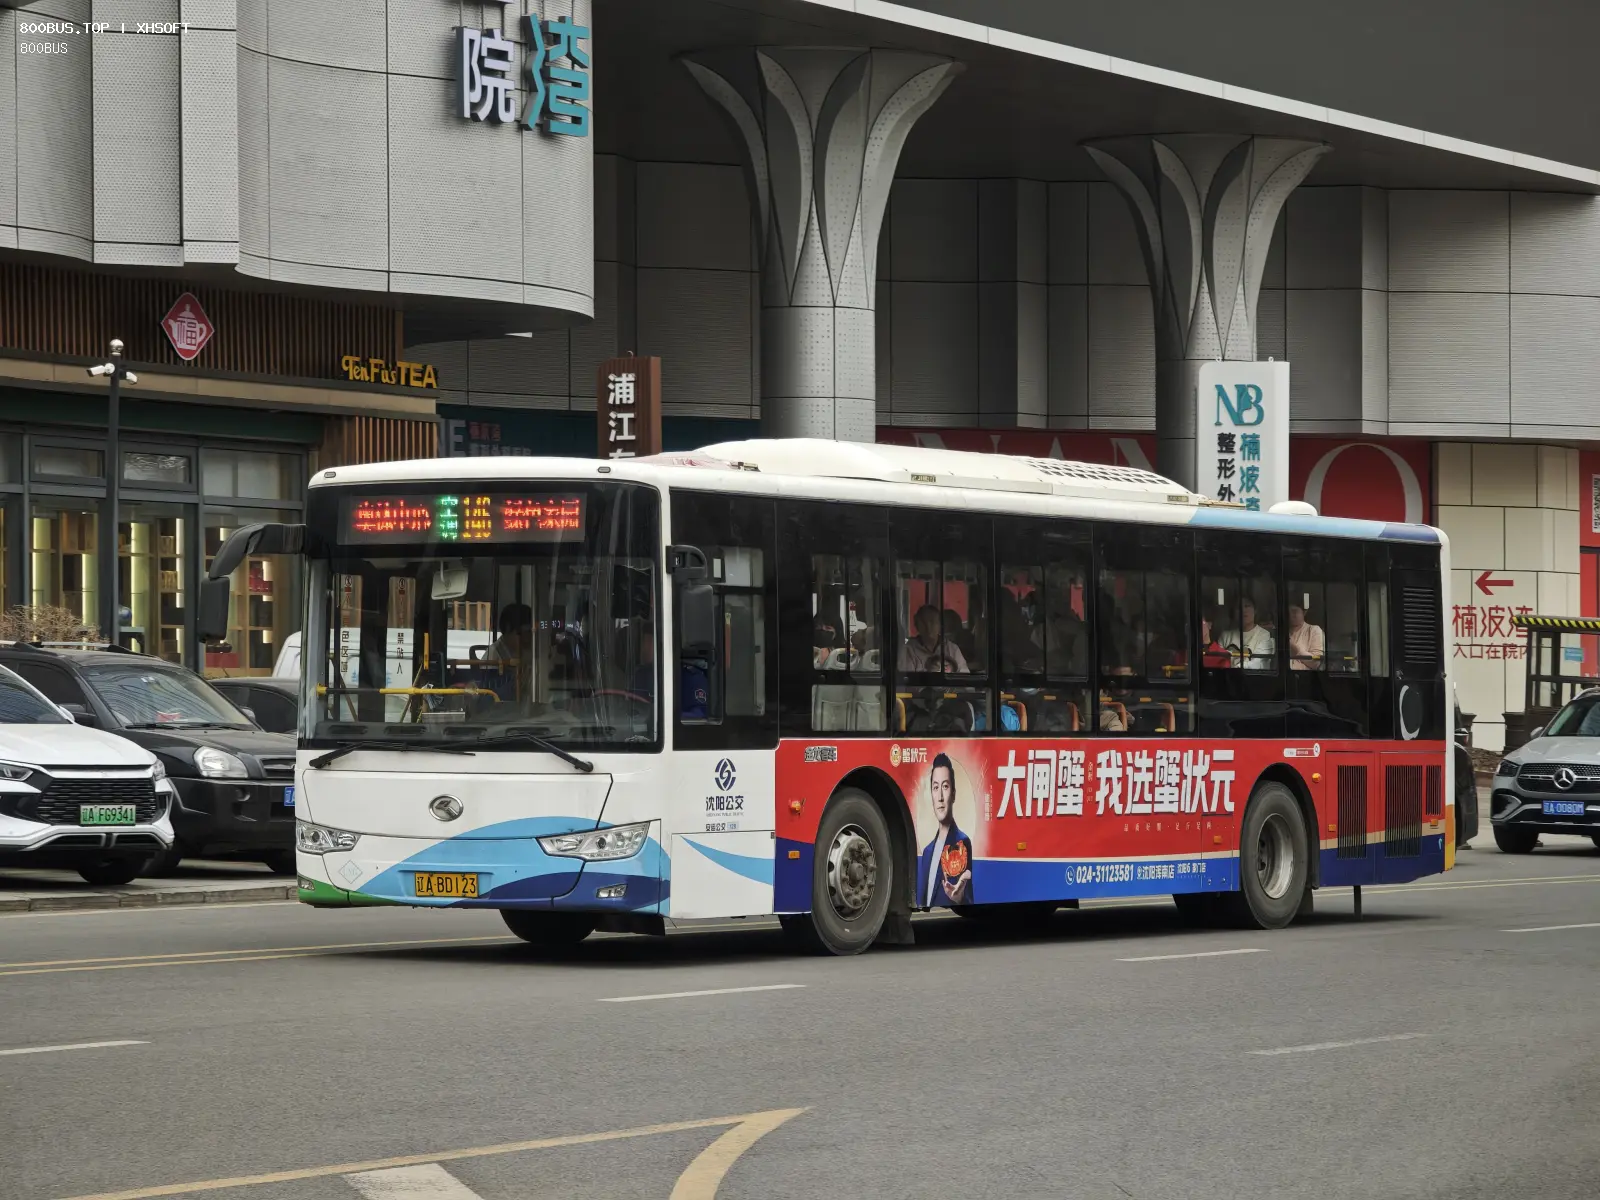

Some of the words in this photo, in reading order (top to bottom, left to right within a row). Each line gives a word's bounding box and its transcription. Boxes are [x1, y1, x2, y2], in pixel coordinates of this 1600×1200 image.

[457, 27, 516, 124] 院
[521, 12, 589, 137] 湾
[397, 361, 437, 389] TEA
[1214, 383, 1265, 426] NB
[1217, 432, 1237, 502] 整形外
[1452, 604, 1533, 638] 楠波湾
[705, 795, 745, 811] 沈阳公交
[997, 749, 1085, 819] 大闸蟹
[1096, 749, 1236, 816] 我选蟹状元
[1076, 863, 1135, 884] 024-31123581
